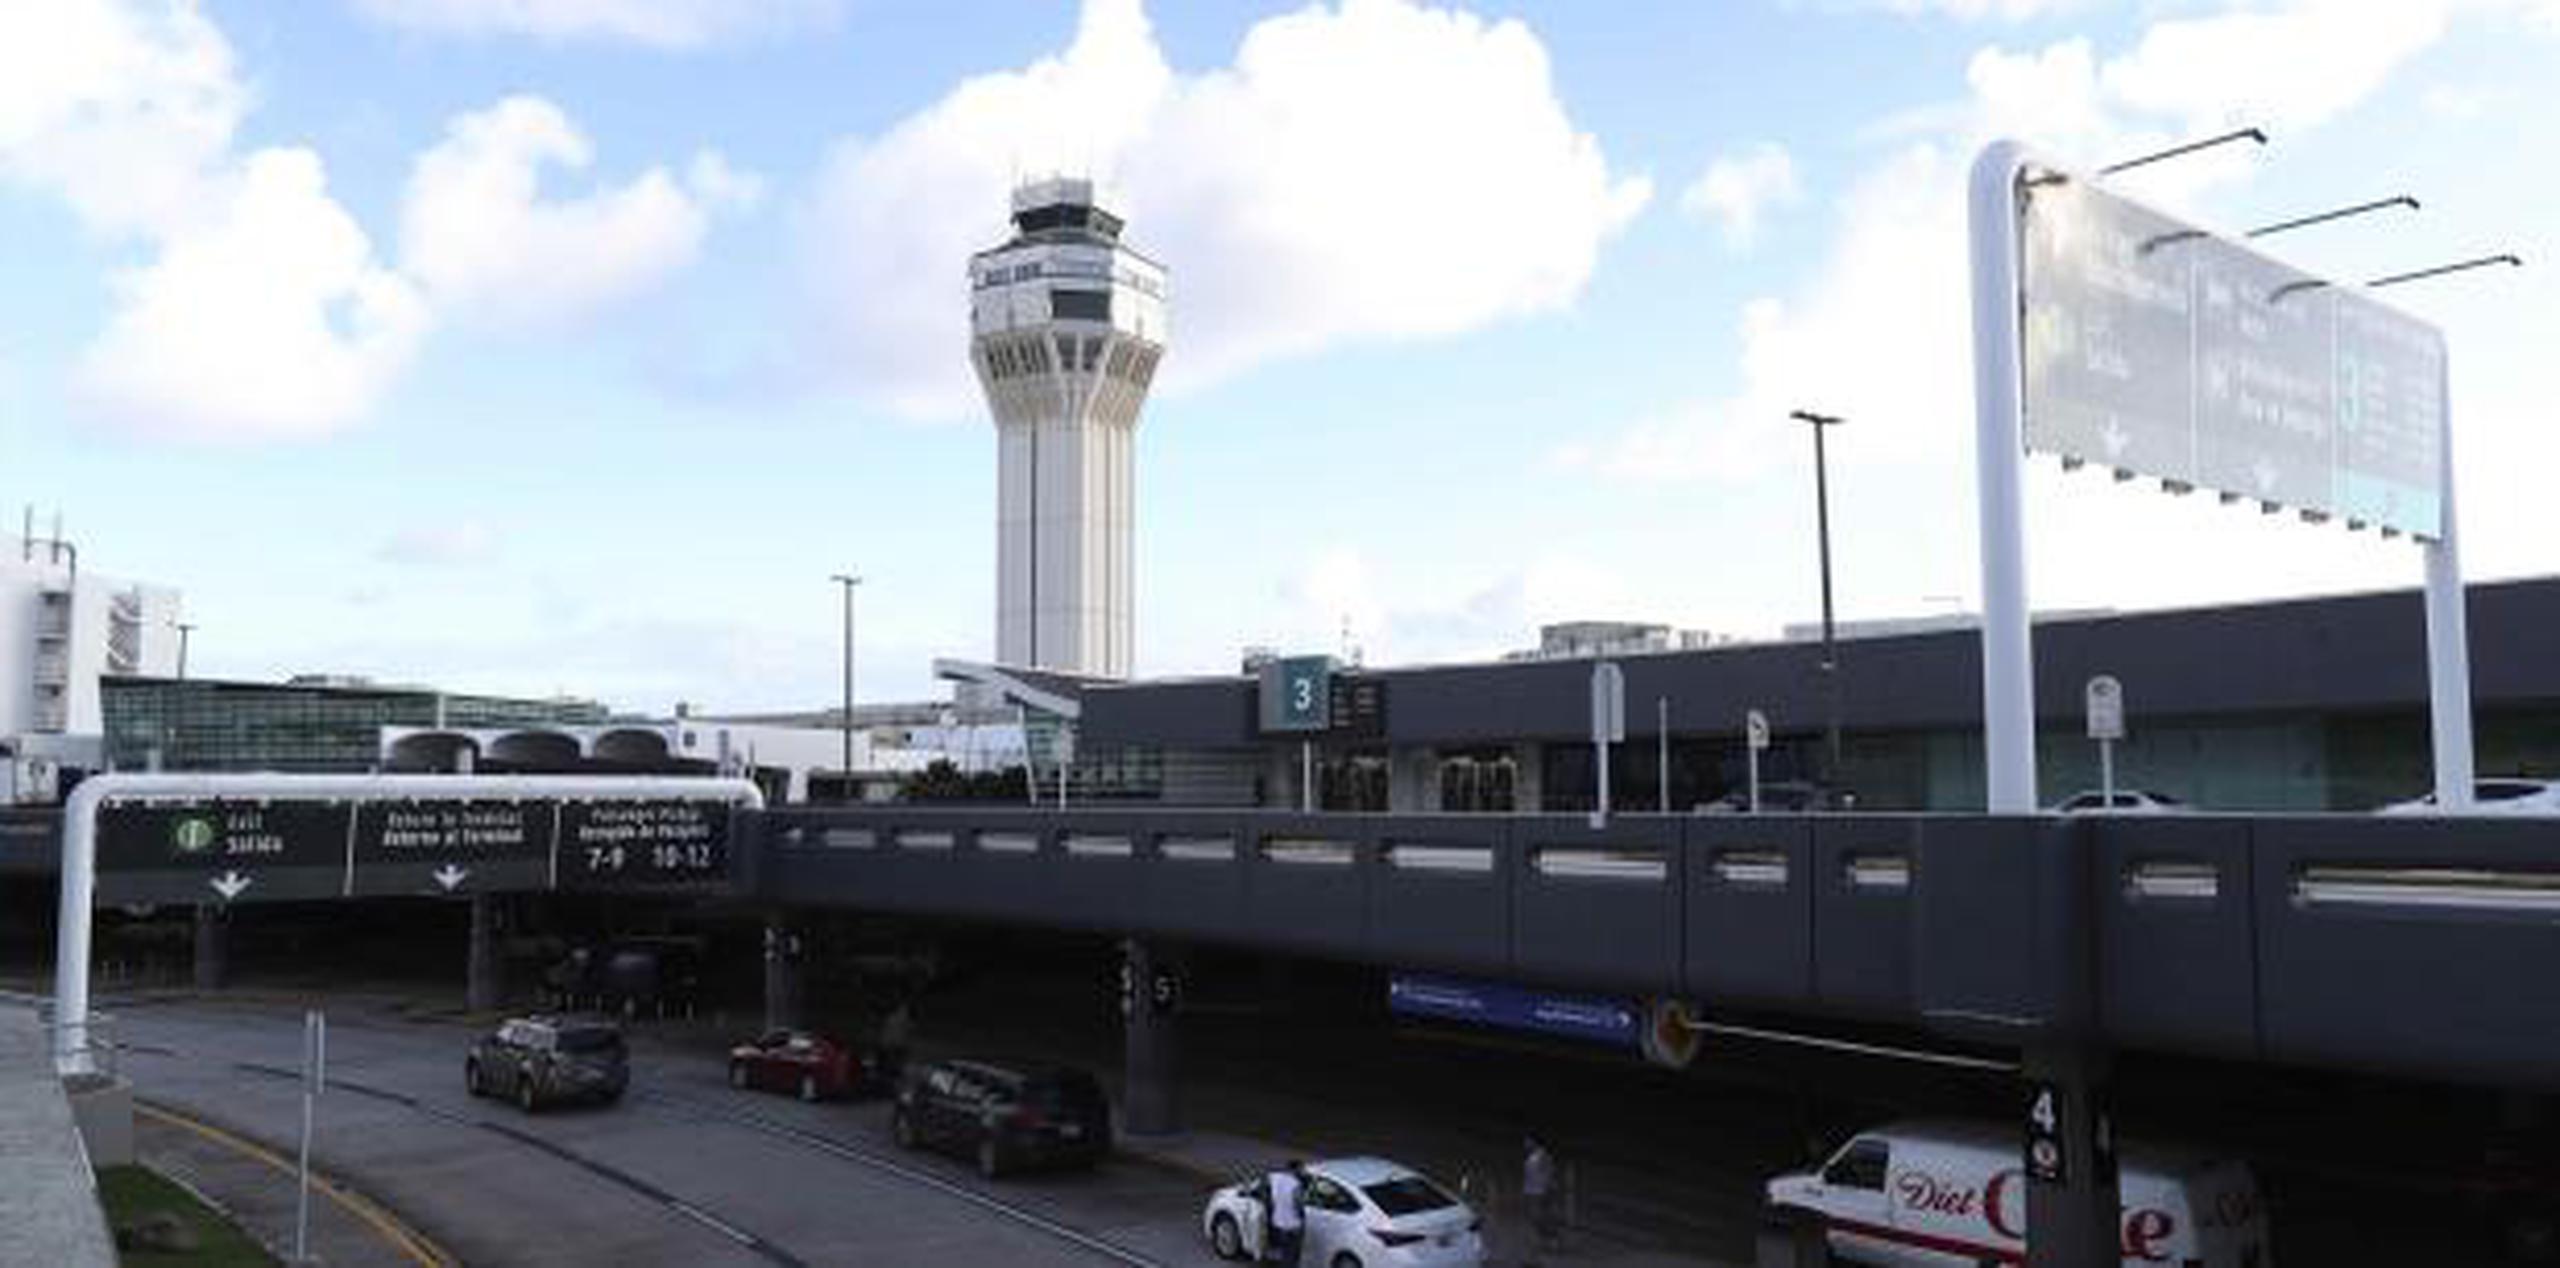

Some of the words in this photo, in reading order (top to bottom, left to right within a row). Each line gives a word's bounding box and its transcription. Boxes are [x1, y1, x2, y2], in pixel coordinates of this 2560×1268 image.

[1294, 677, 1312, 711] 3
[587, 846, 625, 871] 7-9
[652, 844, 710, 868] 10-12
[1154, 976, 1171, 1001] 5
[2032, 1091, 2055, 1134] 4
[1897, 1170, 1976, 1216] Diet
[1984, 1167, 2174, 1261] Ce
